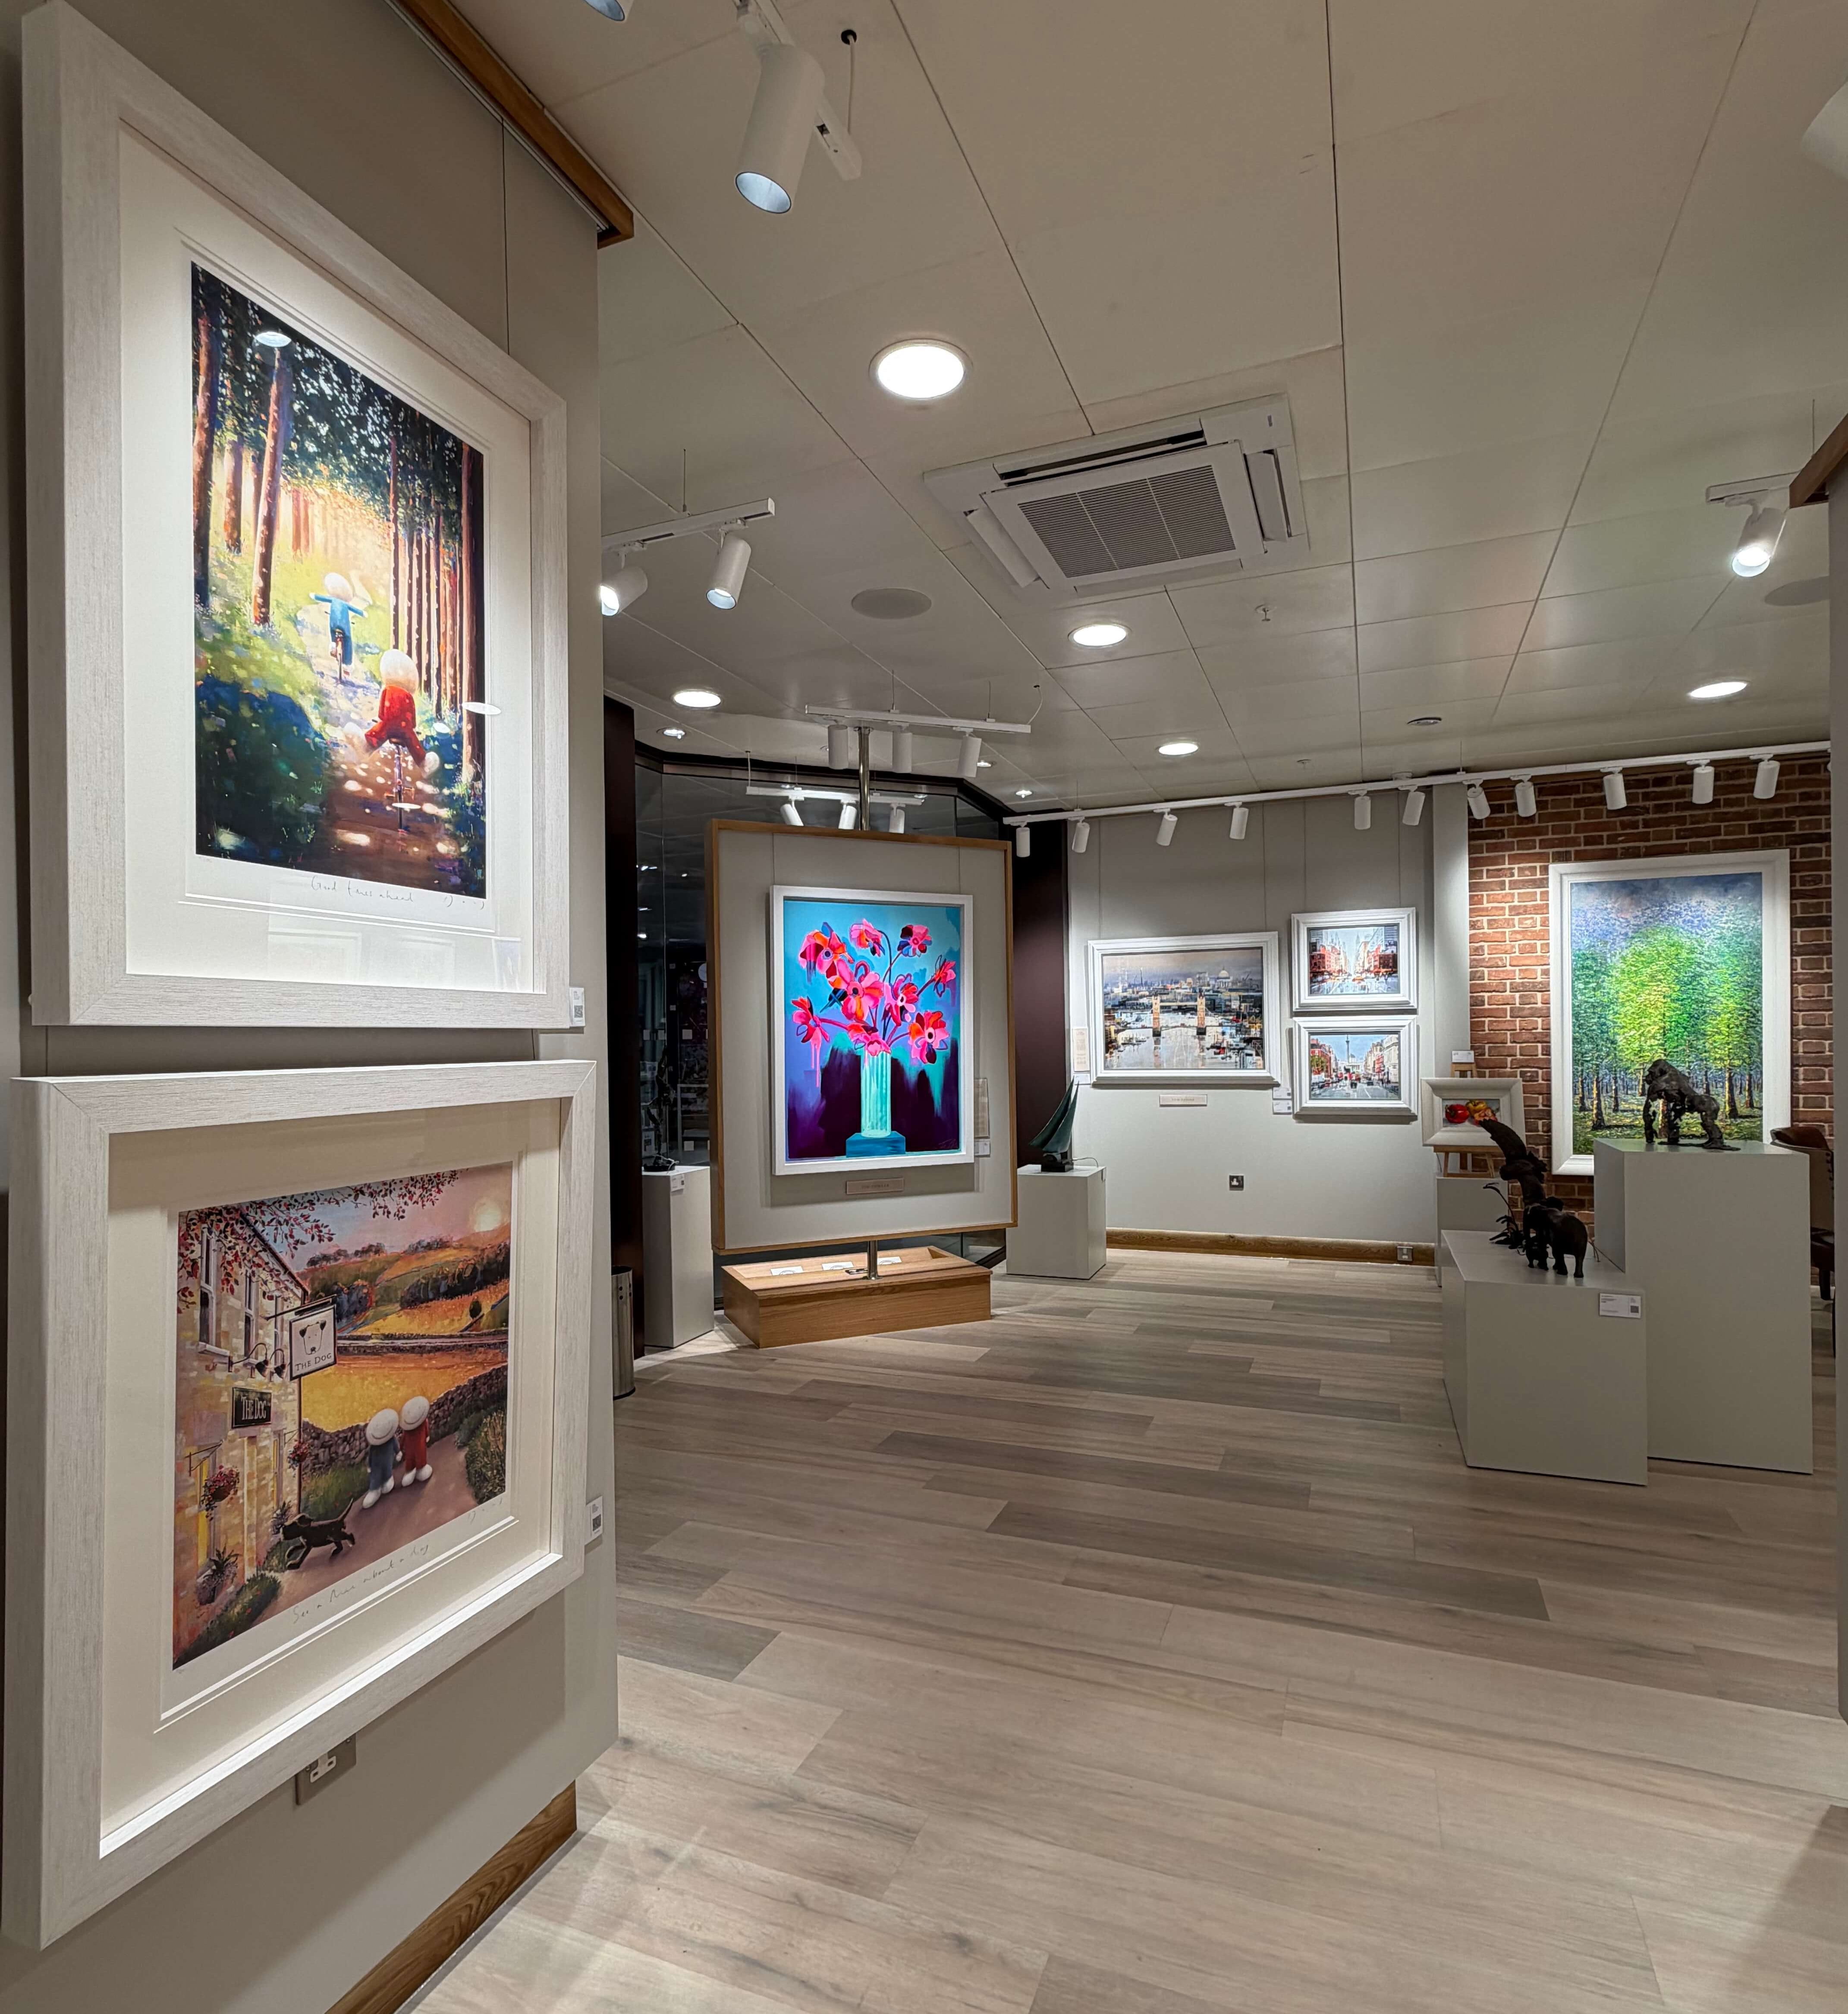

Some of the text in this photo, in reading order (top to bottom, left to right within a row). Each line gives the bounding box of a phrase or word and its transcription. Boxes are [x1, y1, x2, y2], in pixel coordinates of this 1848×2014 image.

[311, 875, 336, 891] Good
[295, 1353, 332, 1371] THE DOG
[241, 1395, 267, 1420] THE DOG
